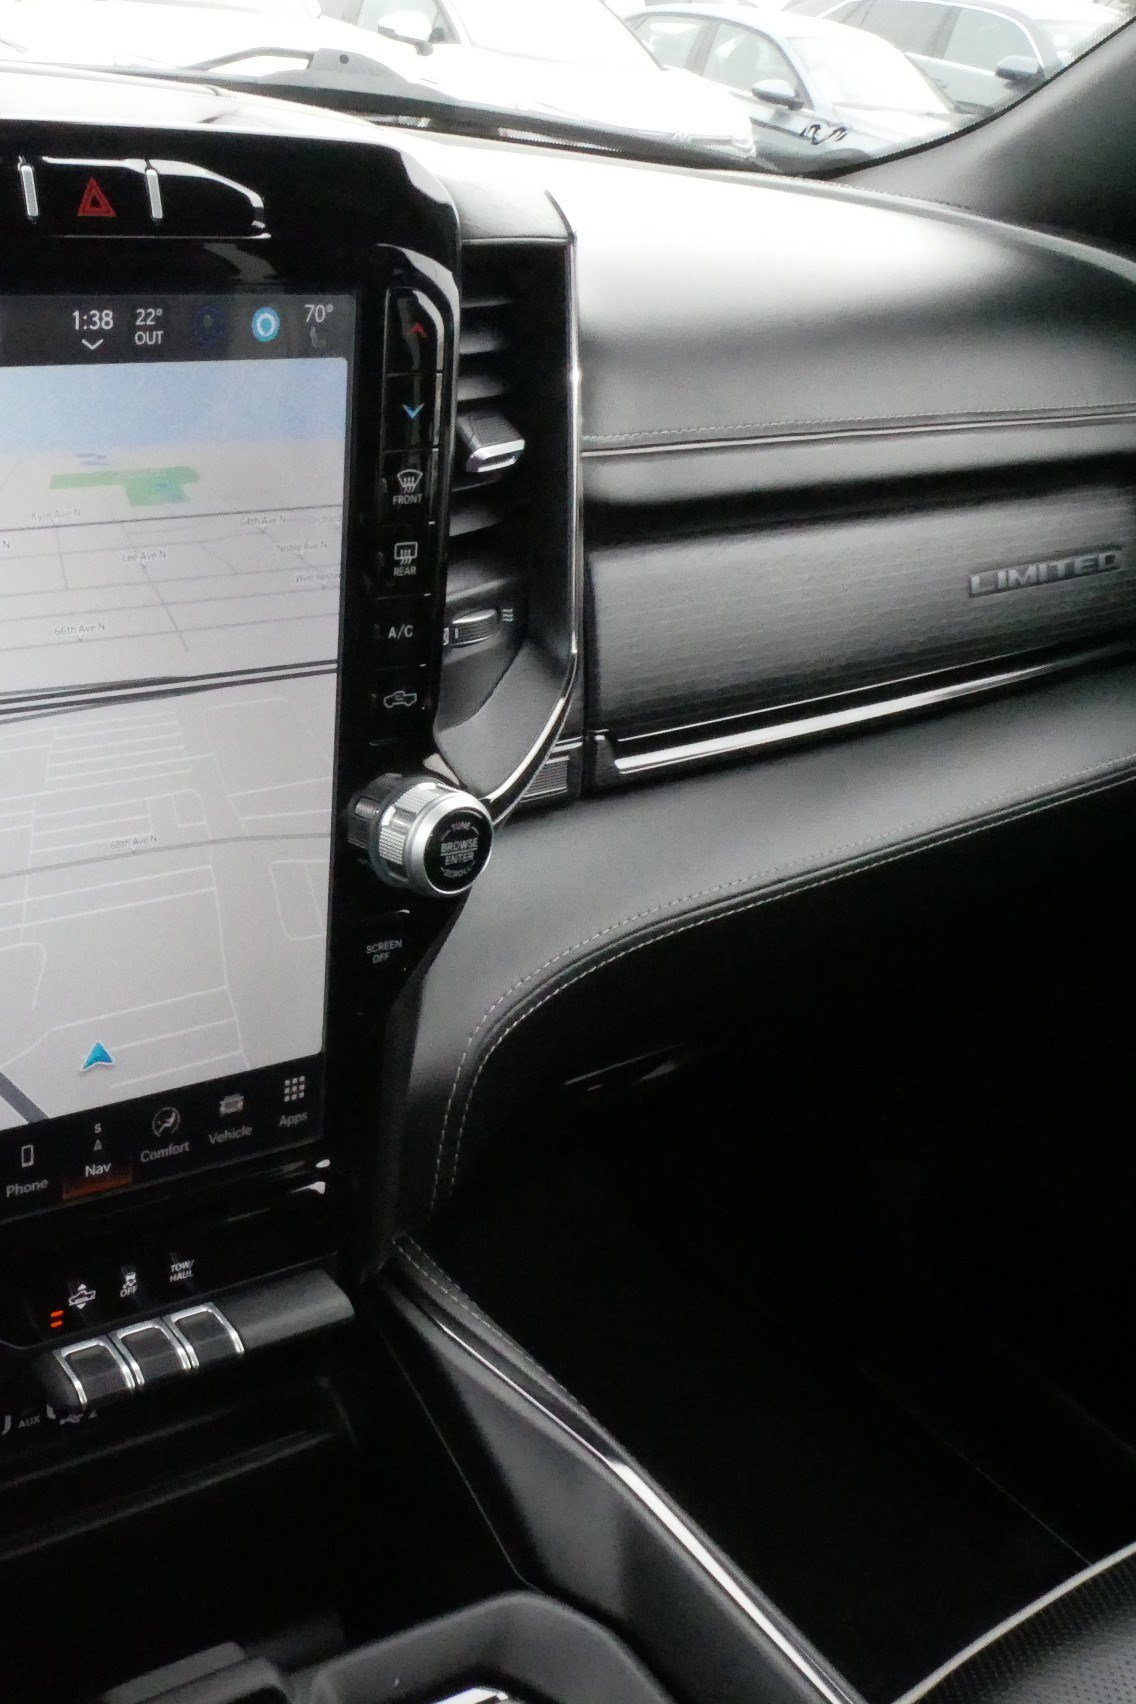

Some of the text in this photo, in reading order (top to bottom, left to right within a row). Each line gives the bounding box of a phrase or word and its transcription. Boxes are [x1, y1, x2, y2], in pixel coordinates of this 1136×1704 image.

[72, 309, 114, 330] 1:38
[135, 308, 163, 326] 22°
[304, 304, 334, 323] 70°
[134, 330, 164, 346] OUT
[392, 494, 423, 505] FRONT
[2, 540, 11, 549] N
[140, 551, 157, 561] Ave
[393, 566, 417, 577] REAR
[968, 551, 1120, 596] LIMITED
[54, 622, 106, 636] 66th Ave N
[387, 624, 414, 639] A/C
[440, 837, 479, 853] BROWSE
[444, 851, 475, 866] ENTER
[366, 939, 403, 954] SCREEN
[372, 951, 390, 964] OFF
[278, 1111, 309, 1128] Apps
[208, 1125, 253, 1145] Vehicle
[140, 1140, 191, 1163] Comfort
[85, 1161, 112, 1178] Nav
[6, 1178, 49, 1198] Phone
[168, 1271, 194, 1283] HAUL
[119, 1285, 138, 1298] OFF
[17, 1414, 41, 1429] AUX
